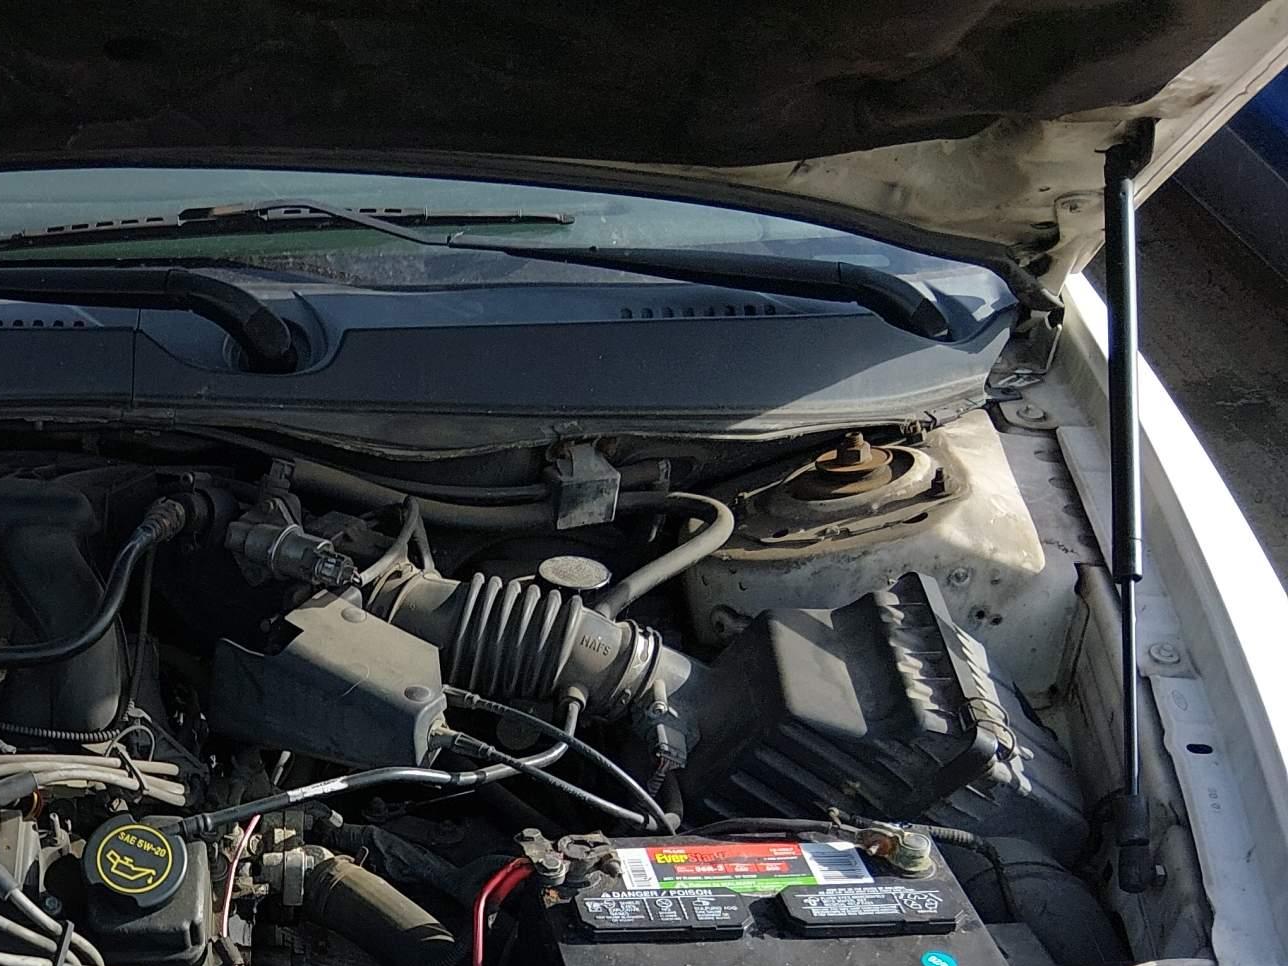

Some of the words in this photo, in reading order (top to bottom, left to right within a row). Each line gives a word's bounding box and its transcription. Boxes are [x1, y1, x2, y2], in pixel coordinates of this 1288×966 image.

[118, 831, 138, 846] SAE
[136, 838, 167, 858] 5W-20
[612, 889, 659, 899] DANGER
[669, 888, 713, 897] POISON
